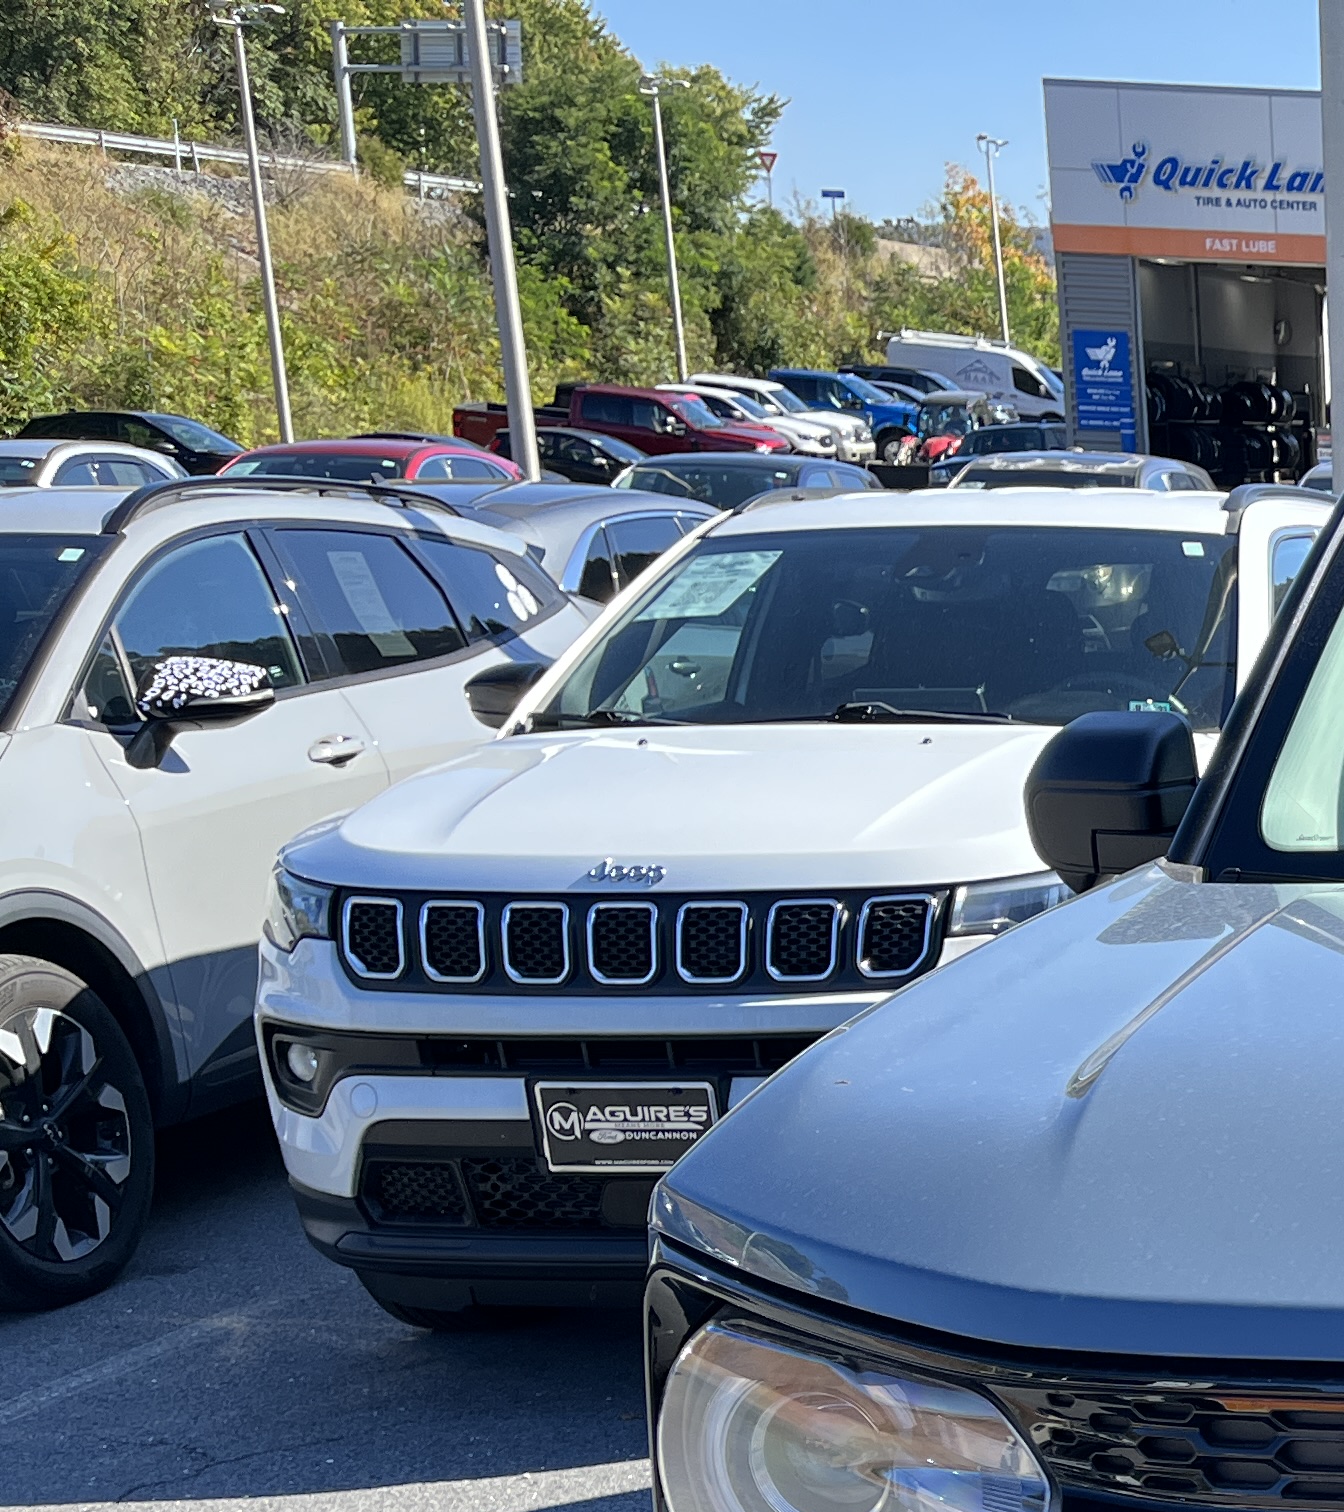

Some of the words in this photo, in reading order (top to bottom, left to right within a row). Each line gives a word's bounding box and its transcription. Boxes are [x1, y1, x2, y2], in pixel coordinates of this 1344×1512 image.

[1152, 156, 1260, 192] Quick
[1262, 161, 1325, 194] Lan
[1195, 195, 1222, 208] TIRE
[1226, 197, 1233, 208] &
[1235, 197, 1267, 210] AUTO
[1270, 198, 1318, 211] CENTER
[1205, 237, 1239, 252] FAST
[1241, 239, 1277, 254] LUBE
[588, 857, 667, 885] Jeep
[625, 1131, 697, 1140] DUNCANNON
